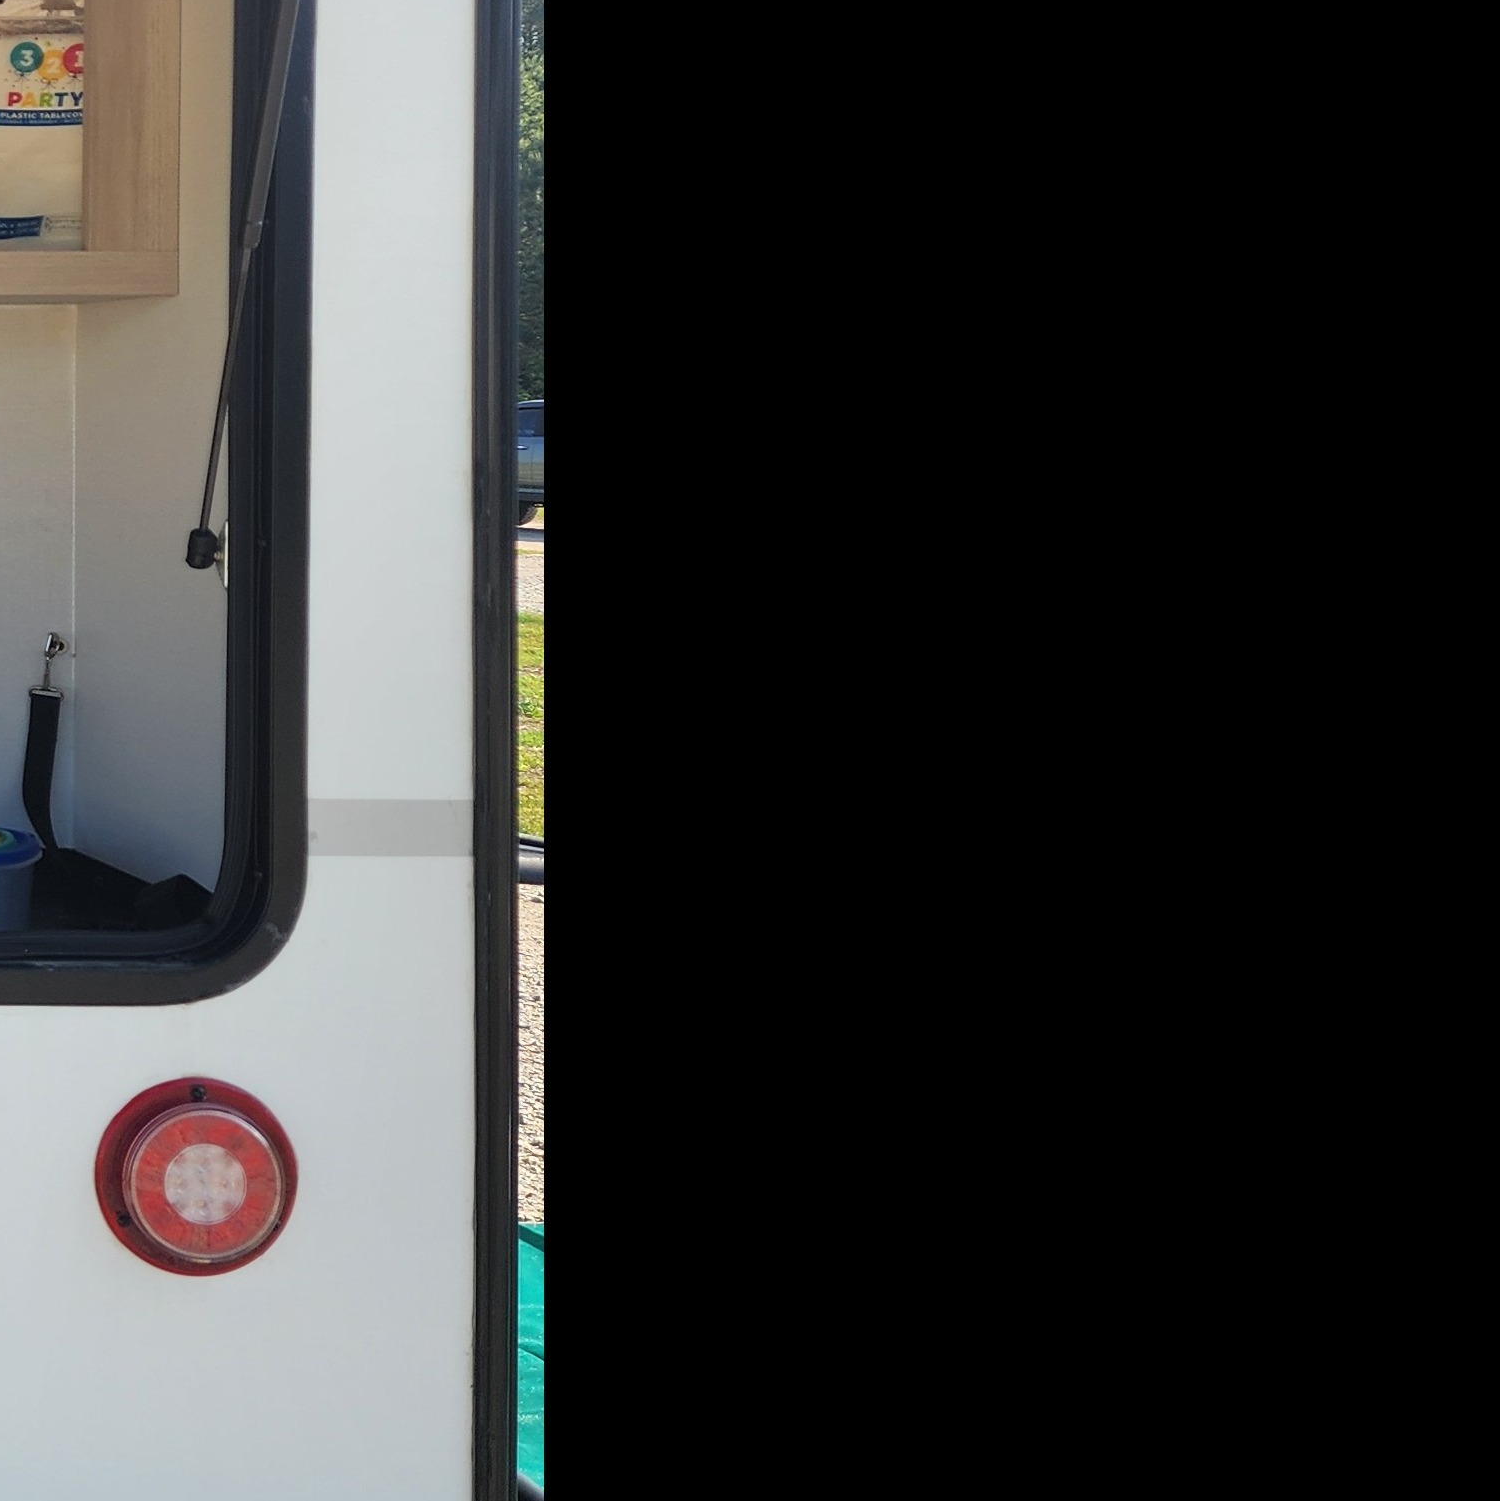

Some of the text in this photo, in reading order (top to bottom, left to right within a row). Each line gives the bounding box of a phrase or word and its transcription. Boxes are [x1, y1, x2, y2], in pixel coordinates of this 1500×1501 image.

[20, 49, 35, 67] 3
[7, 91, 84, 108] PARTY
[0, 111, 83, 120] PLASTIC TABLECO
